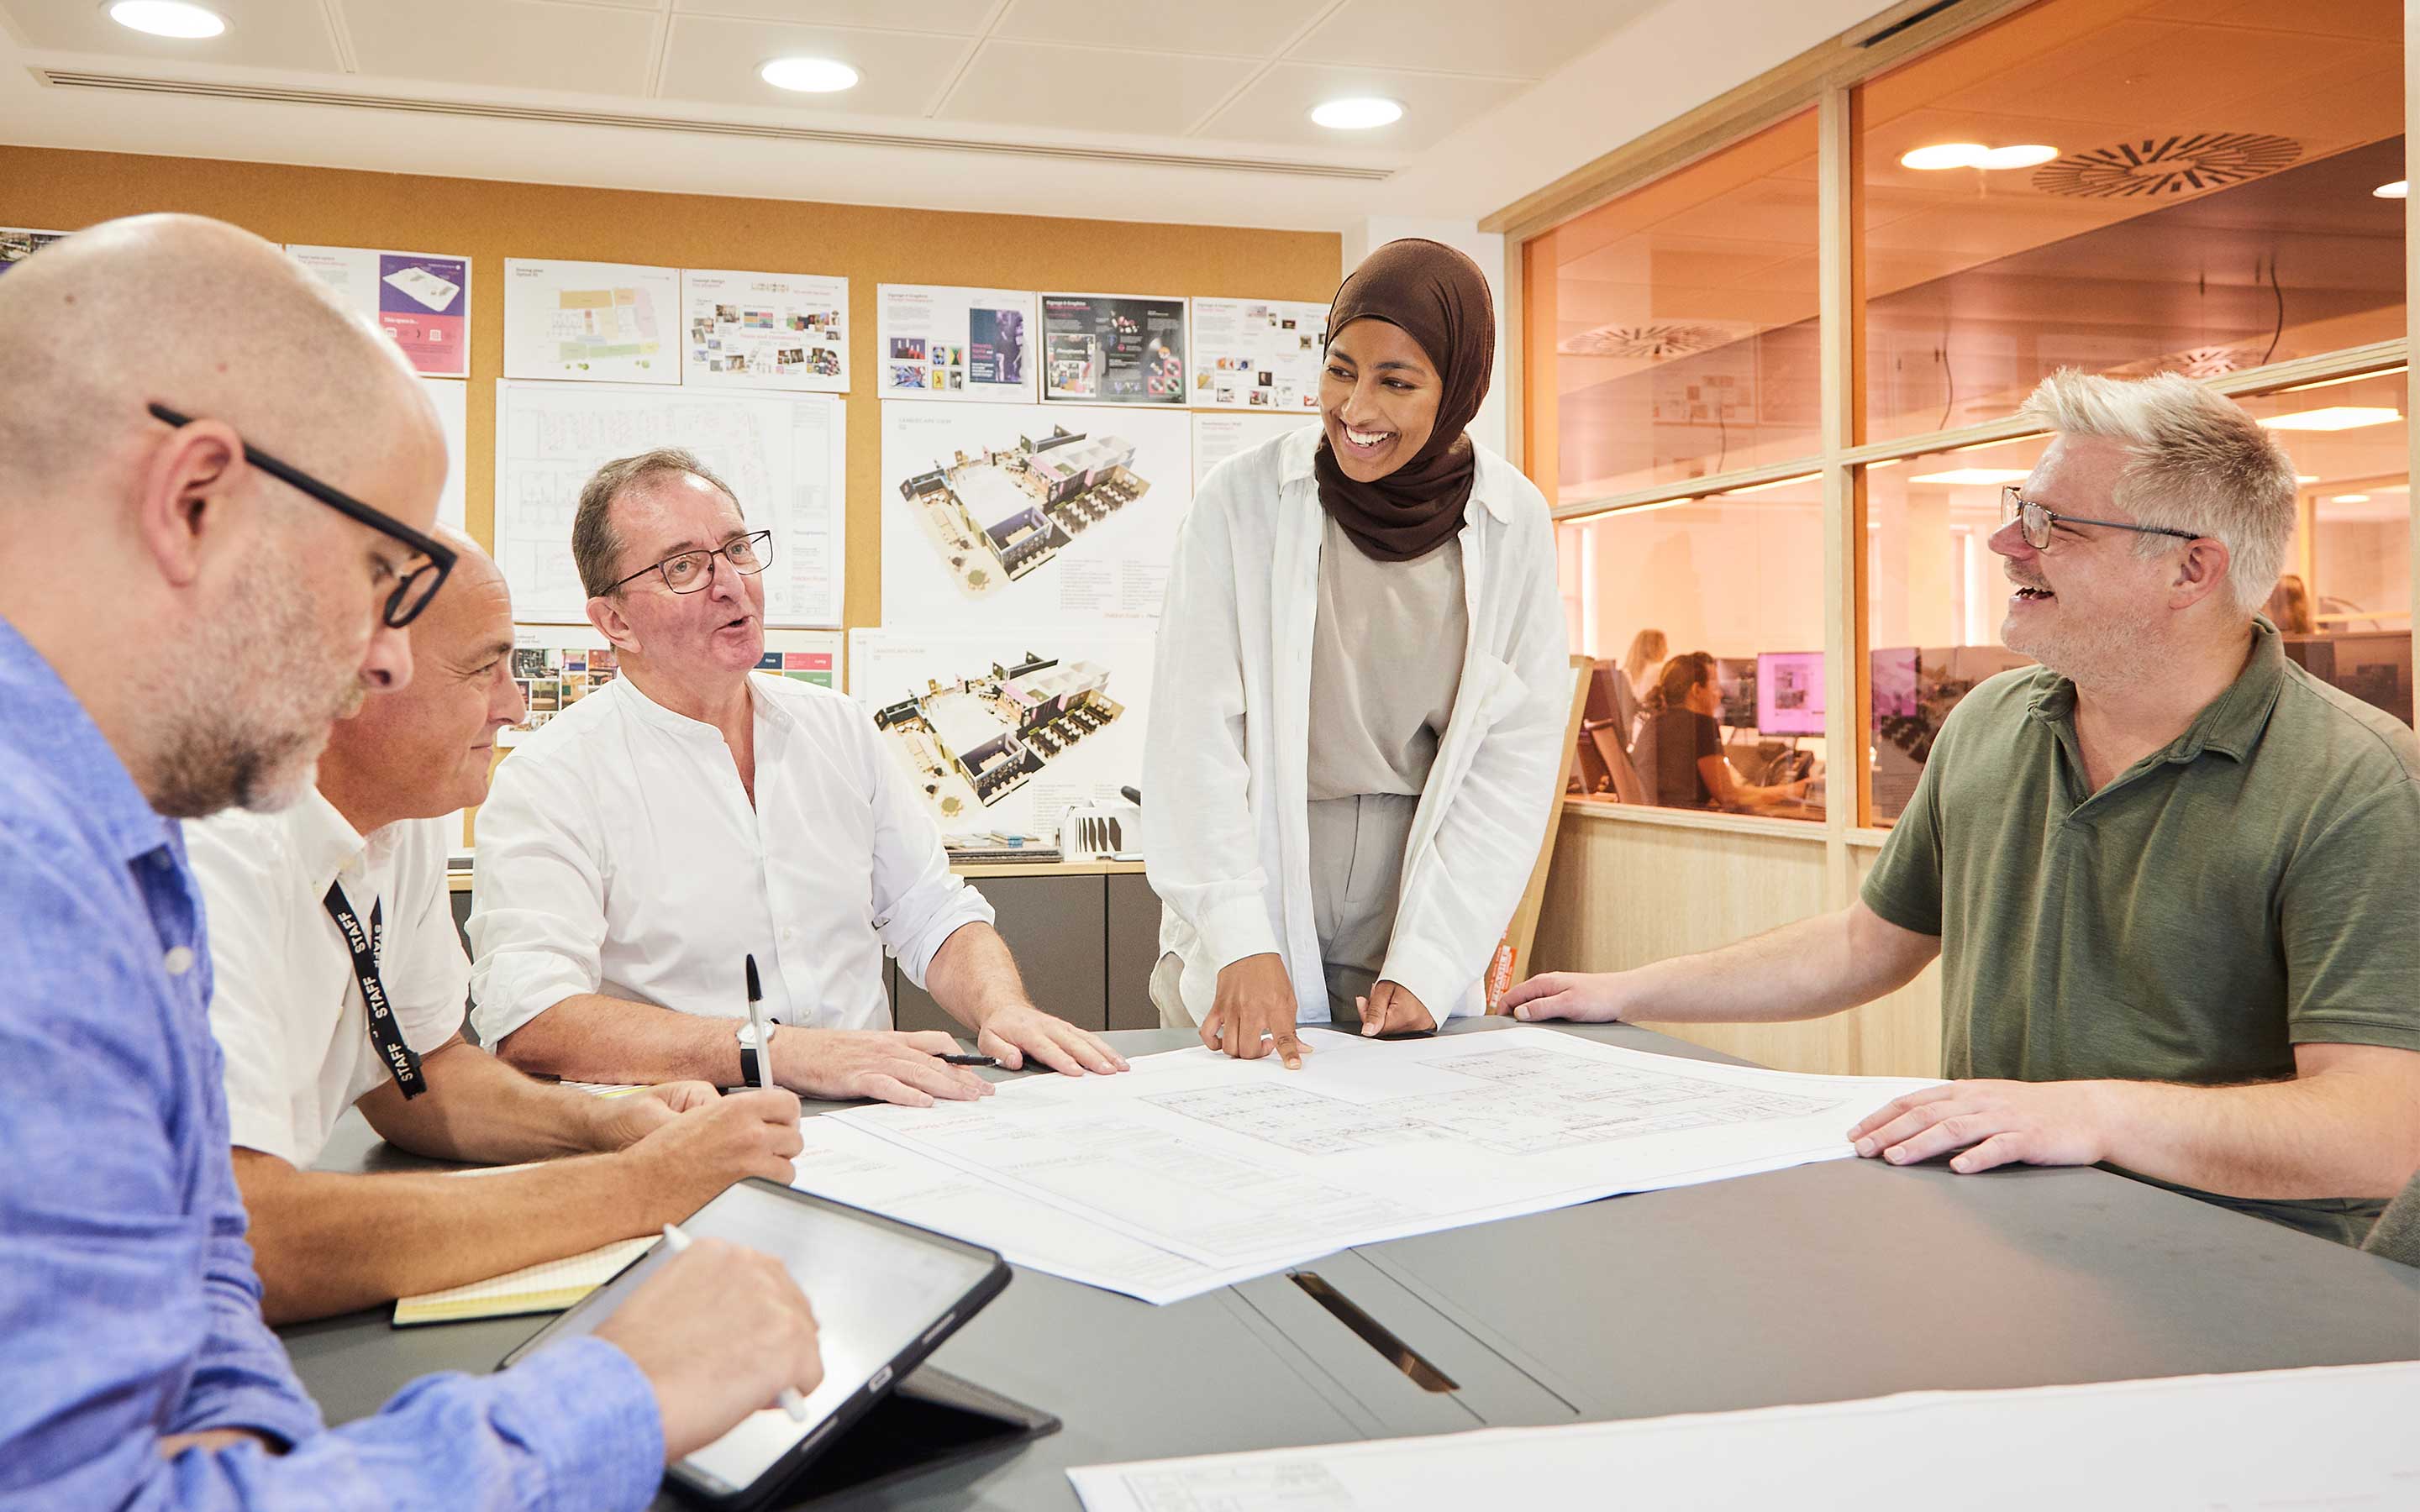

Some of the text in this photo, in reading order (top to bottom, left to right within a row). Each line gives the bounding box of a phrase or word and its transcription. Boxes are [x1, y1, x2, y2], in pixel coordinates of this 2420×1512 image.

[337, 912, 366, 954] STAFF
[362, 976, 388, 1019] STAFF
[387, 1042, 413, 1082] STAFF
